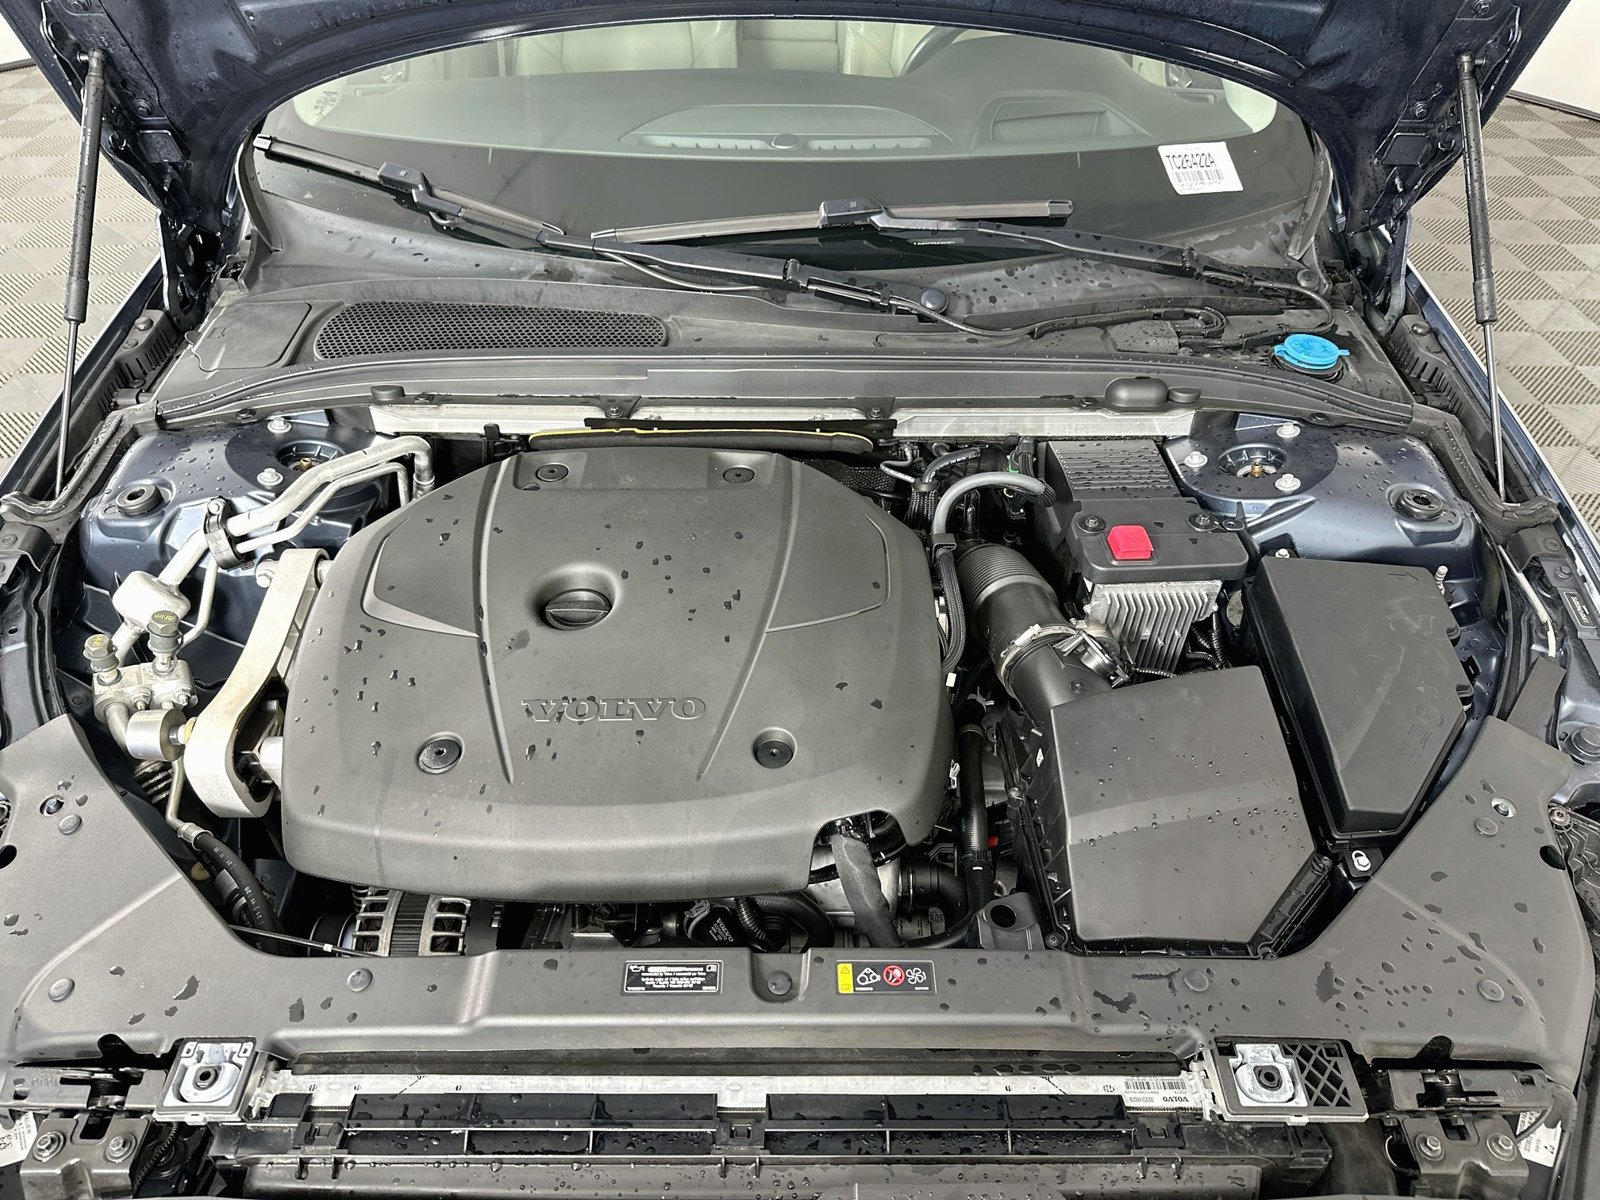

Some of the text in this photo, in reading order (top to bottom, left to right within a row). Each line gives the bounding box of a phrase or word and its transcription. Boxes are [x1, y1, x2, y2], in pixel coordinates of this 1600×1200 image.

[1165, 152, 1217, 170] TC26422A
[521, 697, 706, 722] VOLVO
[716, 917, 734, 942] VOLVO
